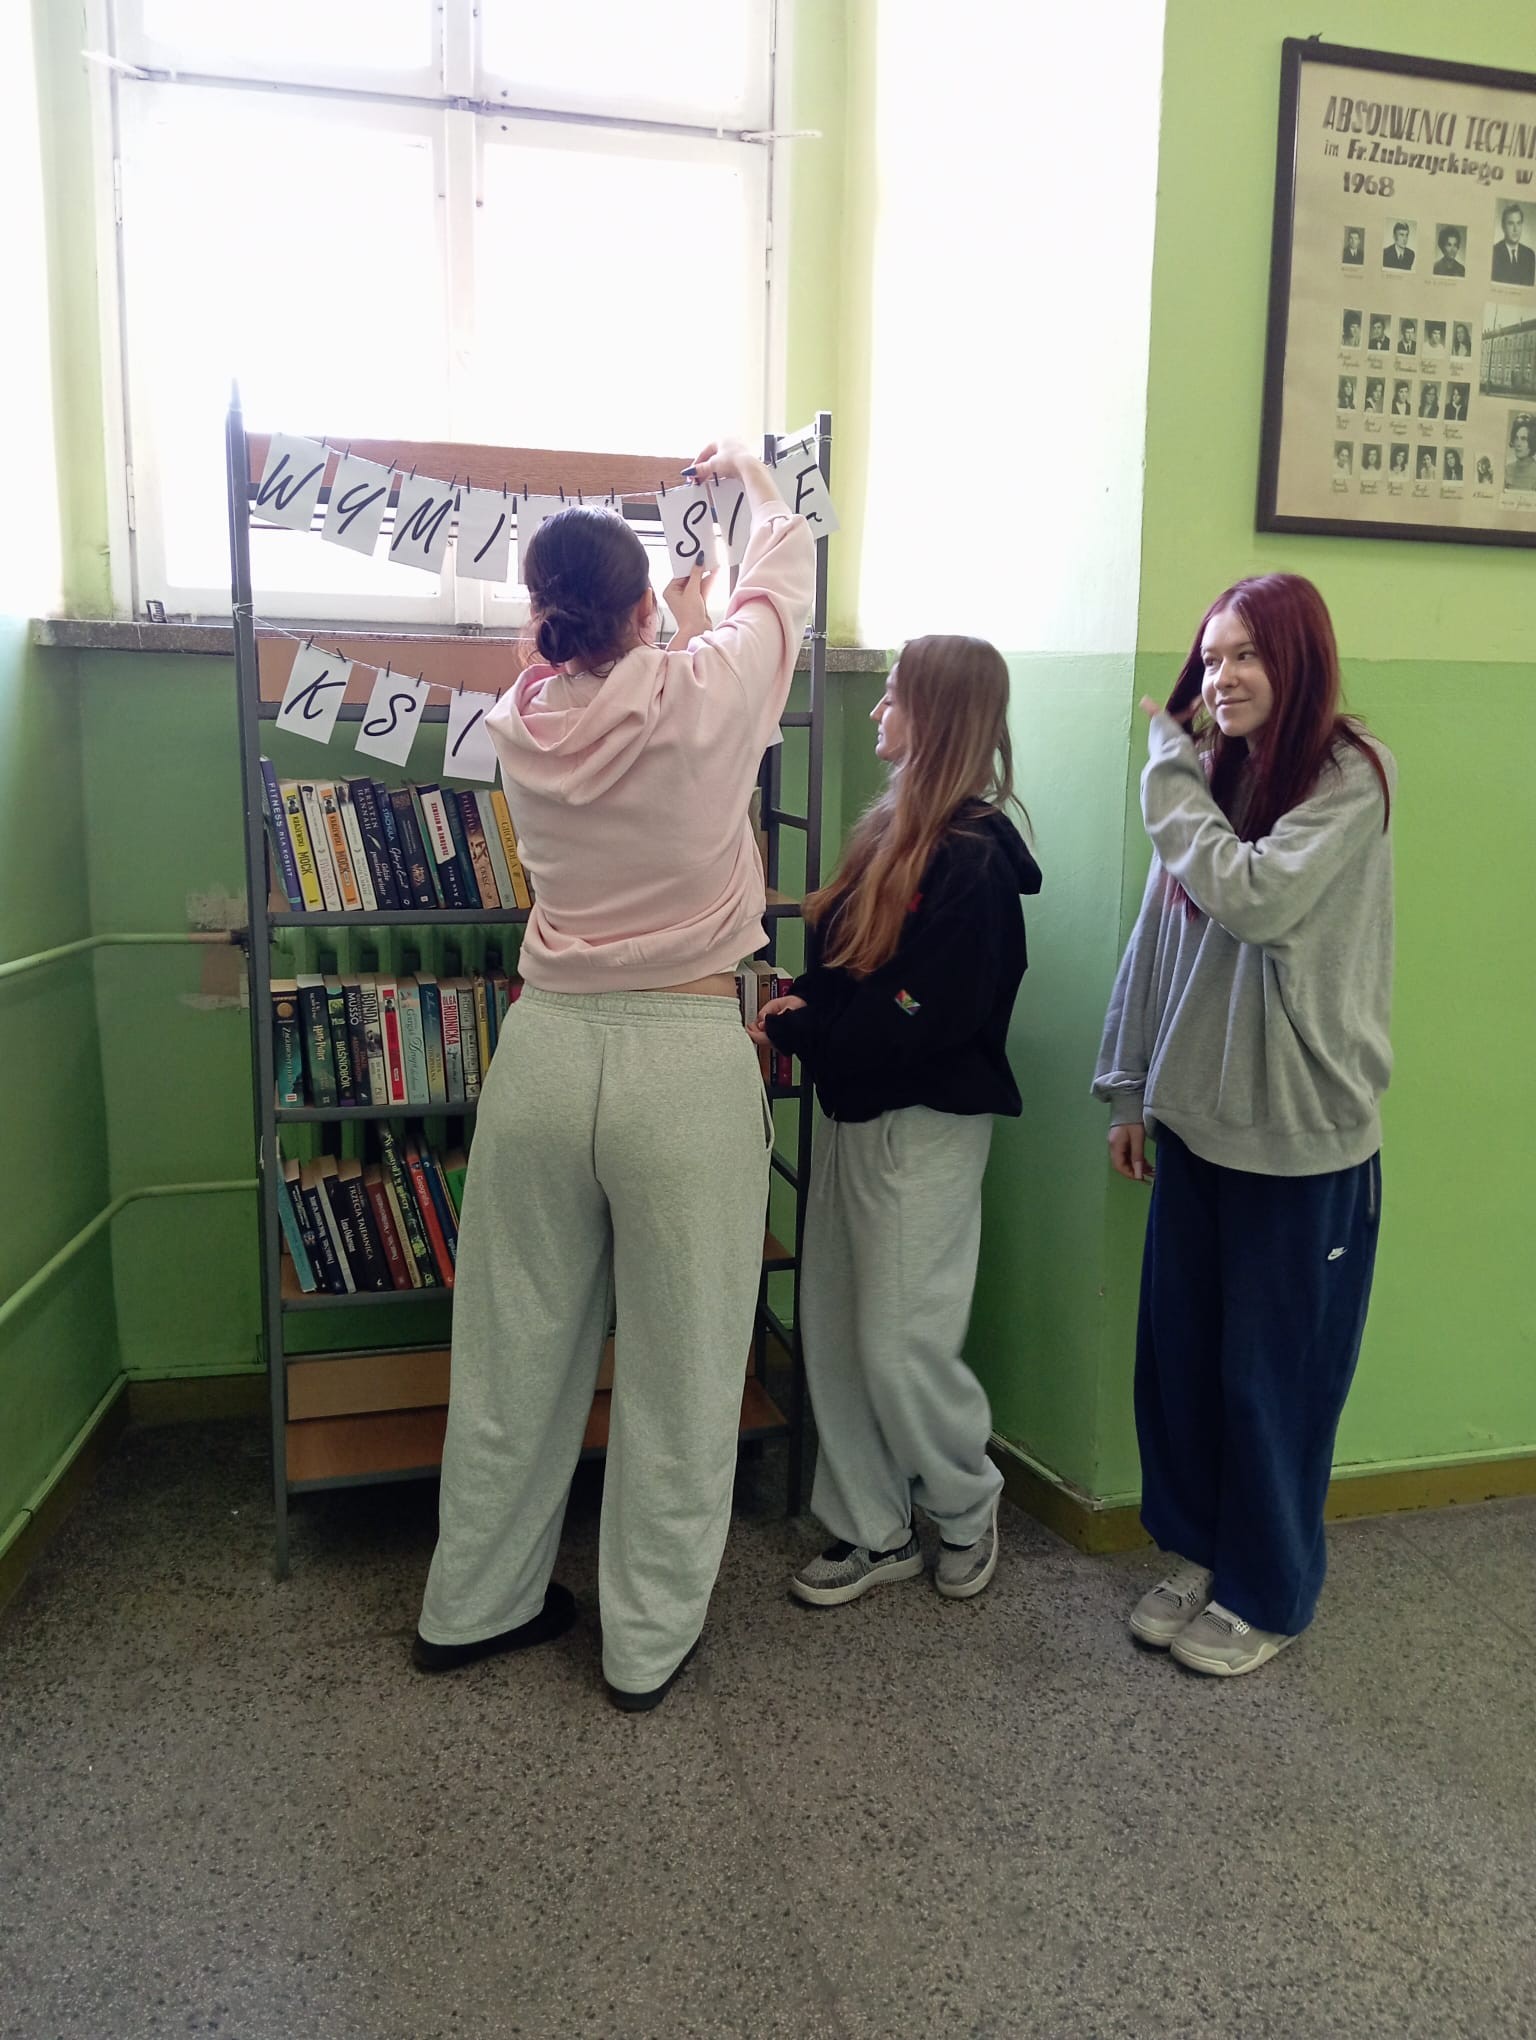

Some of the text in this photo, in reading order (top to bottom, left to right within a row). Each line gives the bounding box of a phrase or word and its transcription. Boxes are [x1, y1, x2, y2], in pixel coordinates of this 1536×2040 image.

[1322, 95, 1457, 147] ABSOLWENCI
[1324, 139, 1339, 157] im
[1515, 168, 1533, 185] w
[1343, 171, 1395, 197] 1968
[256, 453, 618, 563] WYMI
[266, 781, 284, 827] FITNESS
[281, 849, 293, 877] KOBIET
[356, 788, 372, 830] HANNAH
[364, 787, 379, 829] KRISTIN
[292, 815, 313, 876] KRAJEWSKI MOCK
[335, 850, 350, 874] MOCK
[500, 820, 518, 869] GROCHOLA
[347, 992, 359, 1026] MUSSO
[361, 992, 378, 1025] BONDA
[442, 1004, 460, 1046] RUDNICKA
[312, 1024, 326, 1043] Harry
[315, 1042, 326, 1061] Potter
[335, 1040, 351, 1089] BAŚNIOBÓR
[348, 1185, 363, 1219] TRZECIA
[357, 1216, 374, 1261] TAJEMNICA
